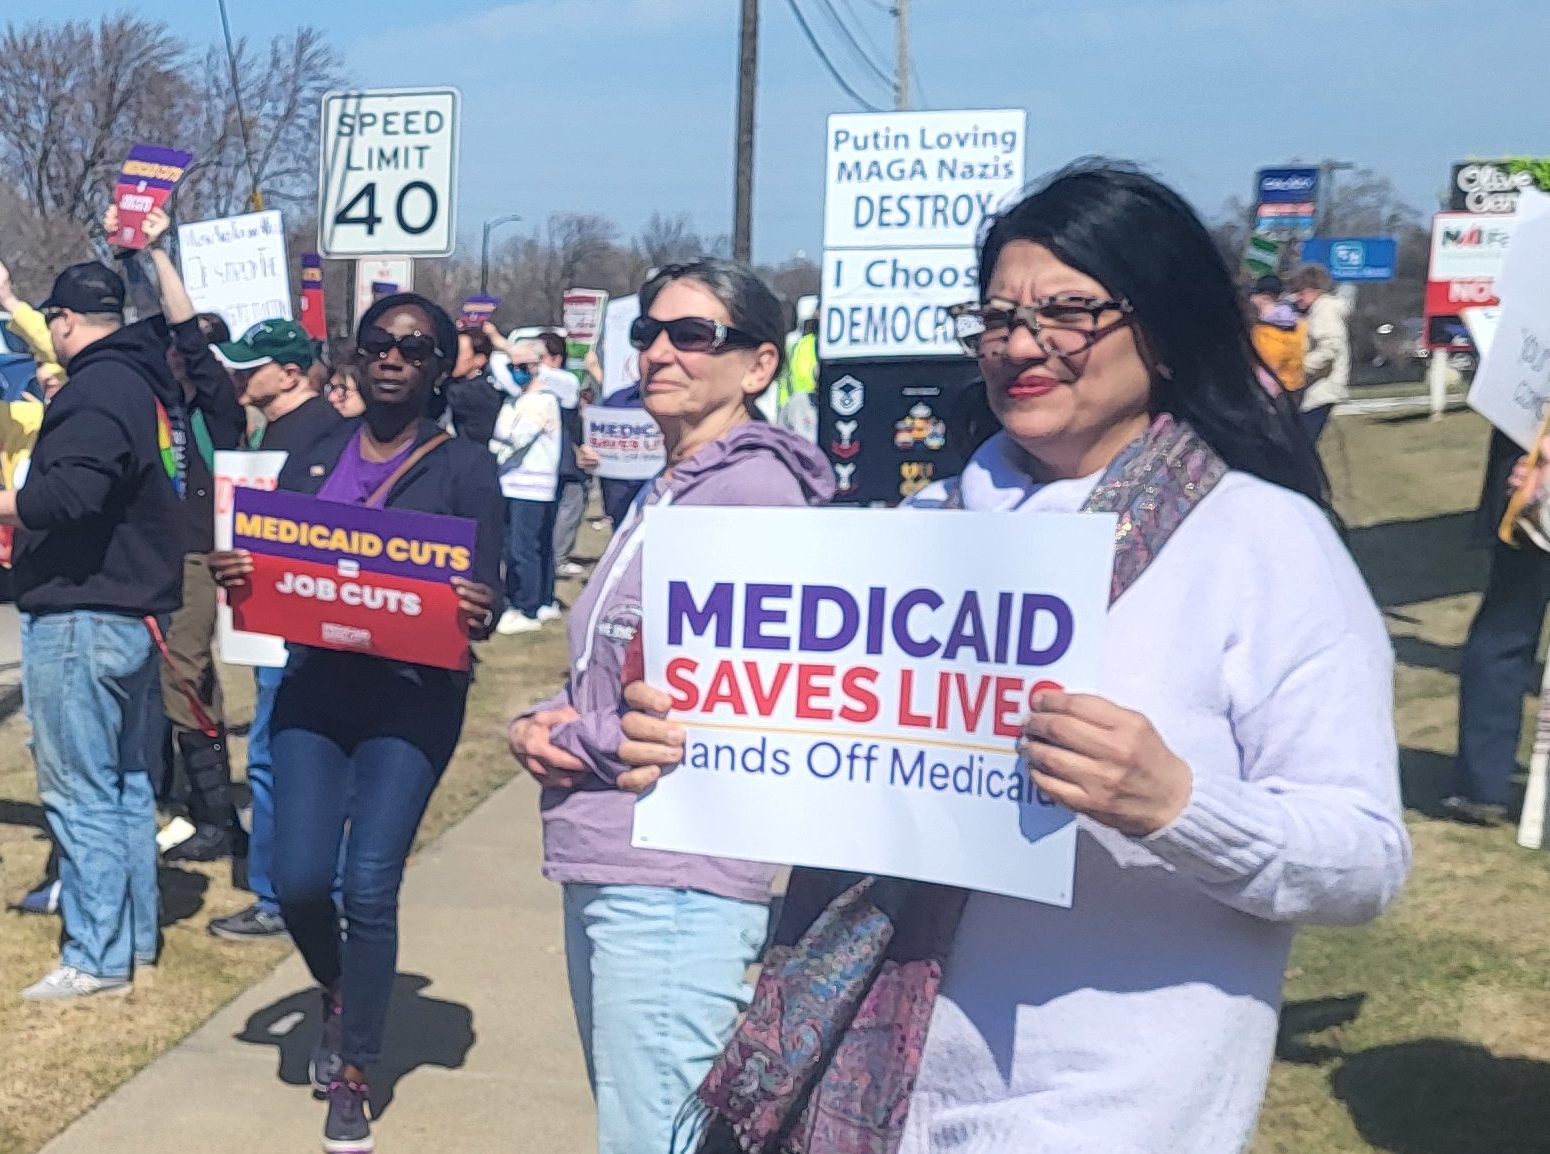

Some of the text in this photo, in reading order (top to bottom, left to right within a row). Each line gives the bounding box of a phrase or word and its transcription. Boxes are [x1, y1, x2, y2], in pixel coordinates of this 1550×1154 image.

[337, 110, 444, 137] SPEED
[834, 124, 1017, 153] Putin Loving
[346, 145, 431, 171] LIMIT
[837, 155, 1014, 183] MAGA Nazis
[334, 180, 438, 236] 40
[854, 191, 993, 229] DESTROY
[834, 259, 979, 288] I Choos
[826, 305, 952, 344] DEMOCR
[235, 512, 470, 571] MEDICAID CUTS
[275, 572, 422, 616] JOB CUTS
[667, 580, 1075, 667] MEDICAID
[666, 656, 880, 724] SAVES
[683, 736, 791, 777] ands
[807, 741, 880, 782] Off
